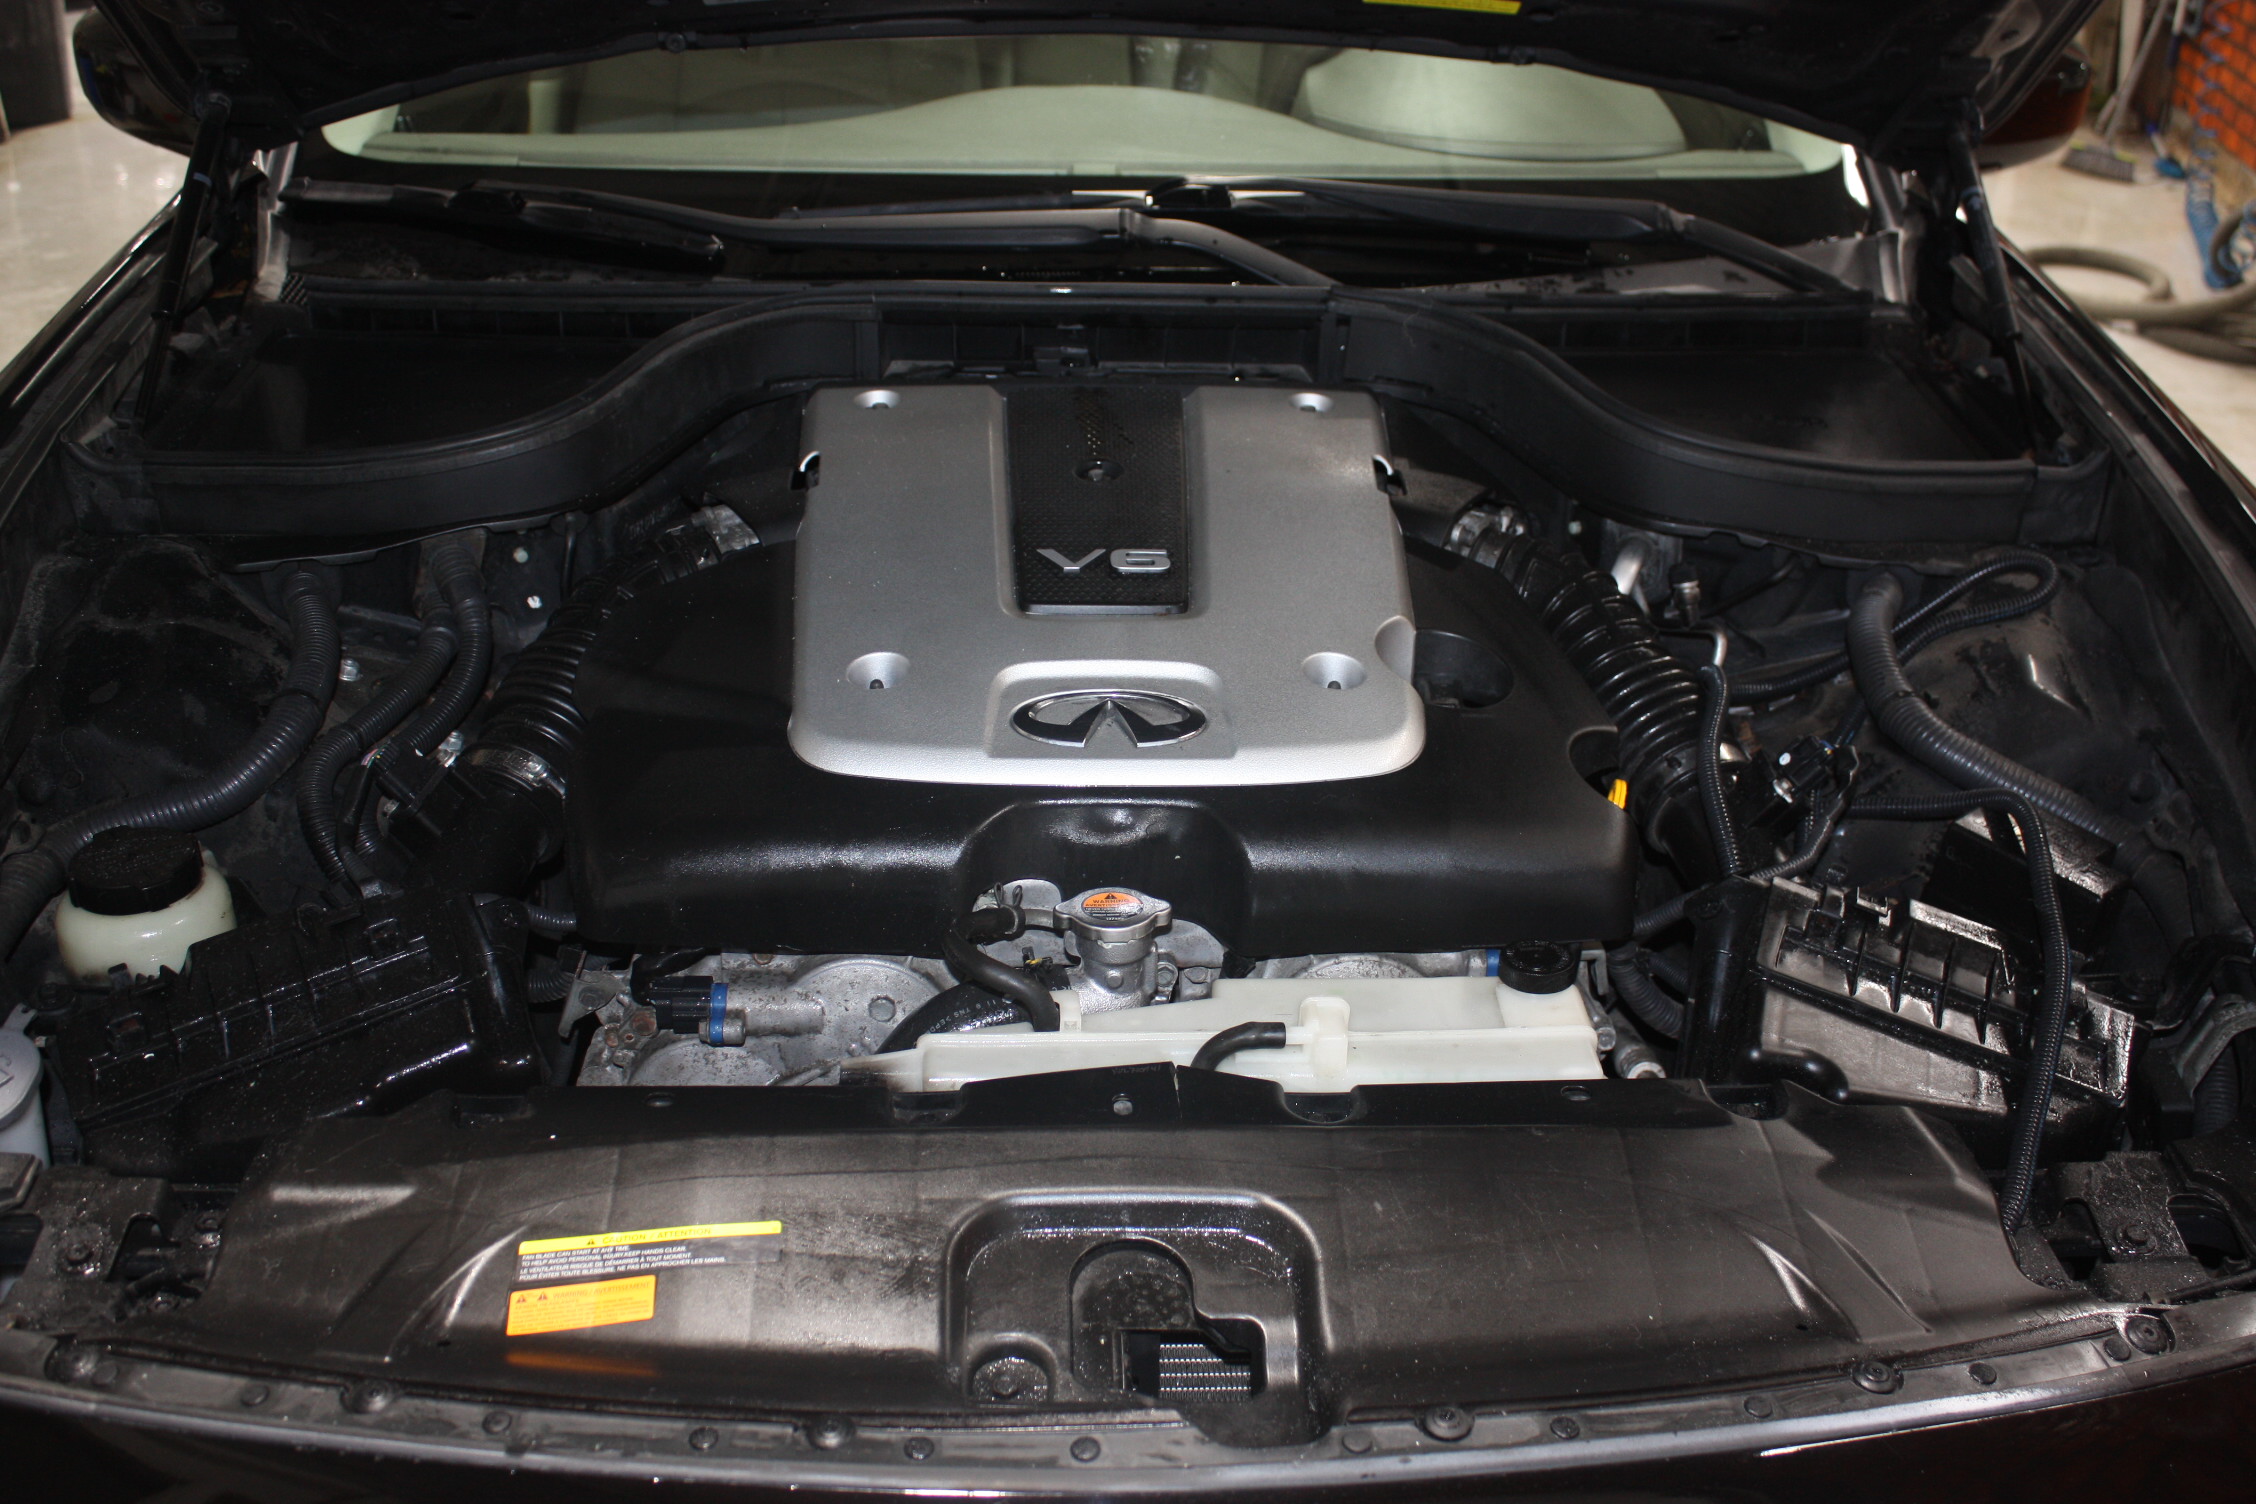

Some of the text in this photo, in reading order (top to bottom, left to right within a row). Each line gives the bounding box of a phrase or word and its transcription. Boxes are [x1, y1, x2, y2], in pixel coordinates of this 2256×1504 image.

[1036, 548, 1171, 573] V6
[602, 1234, 646, 1244] CAUTION
[657, 1228, 711, 1239] ATTENTION
[547, 1257, 567, 1265] AVOID
[568, 1254, 602, 1263] PERSONAL
[641, 1248, 664, 1256] HANDS
[572, 1249, 591, 1257] START
[529, 1264, 569, 1273] VENTILATEUR
[646, 1254, 662, 1262] TOUT
[561, 1269, 581, 1277] TOUTE
[627, 1263, 640, 1271] PAS
[650, 1258, 690, 1268] APPROCHER
[691, 1257, 703, 1265] LES
[552, 1289, 588, 1300] WARNING
